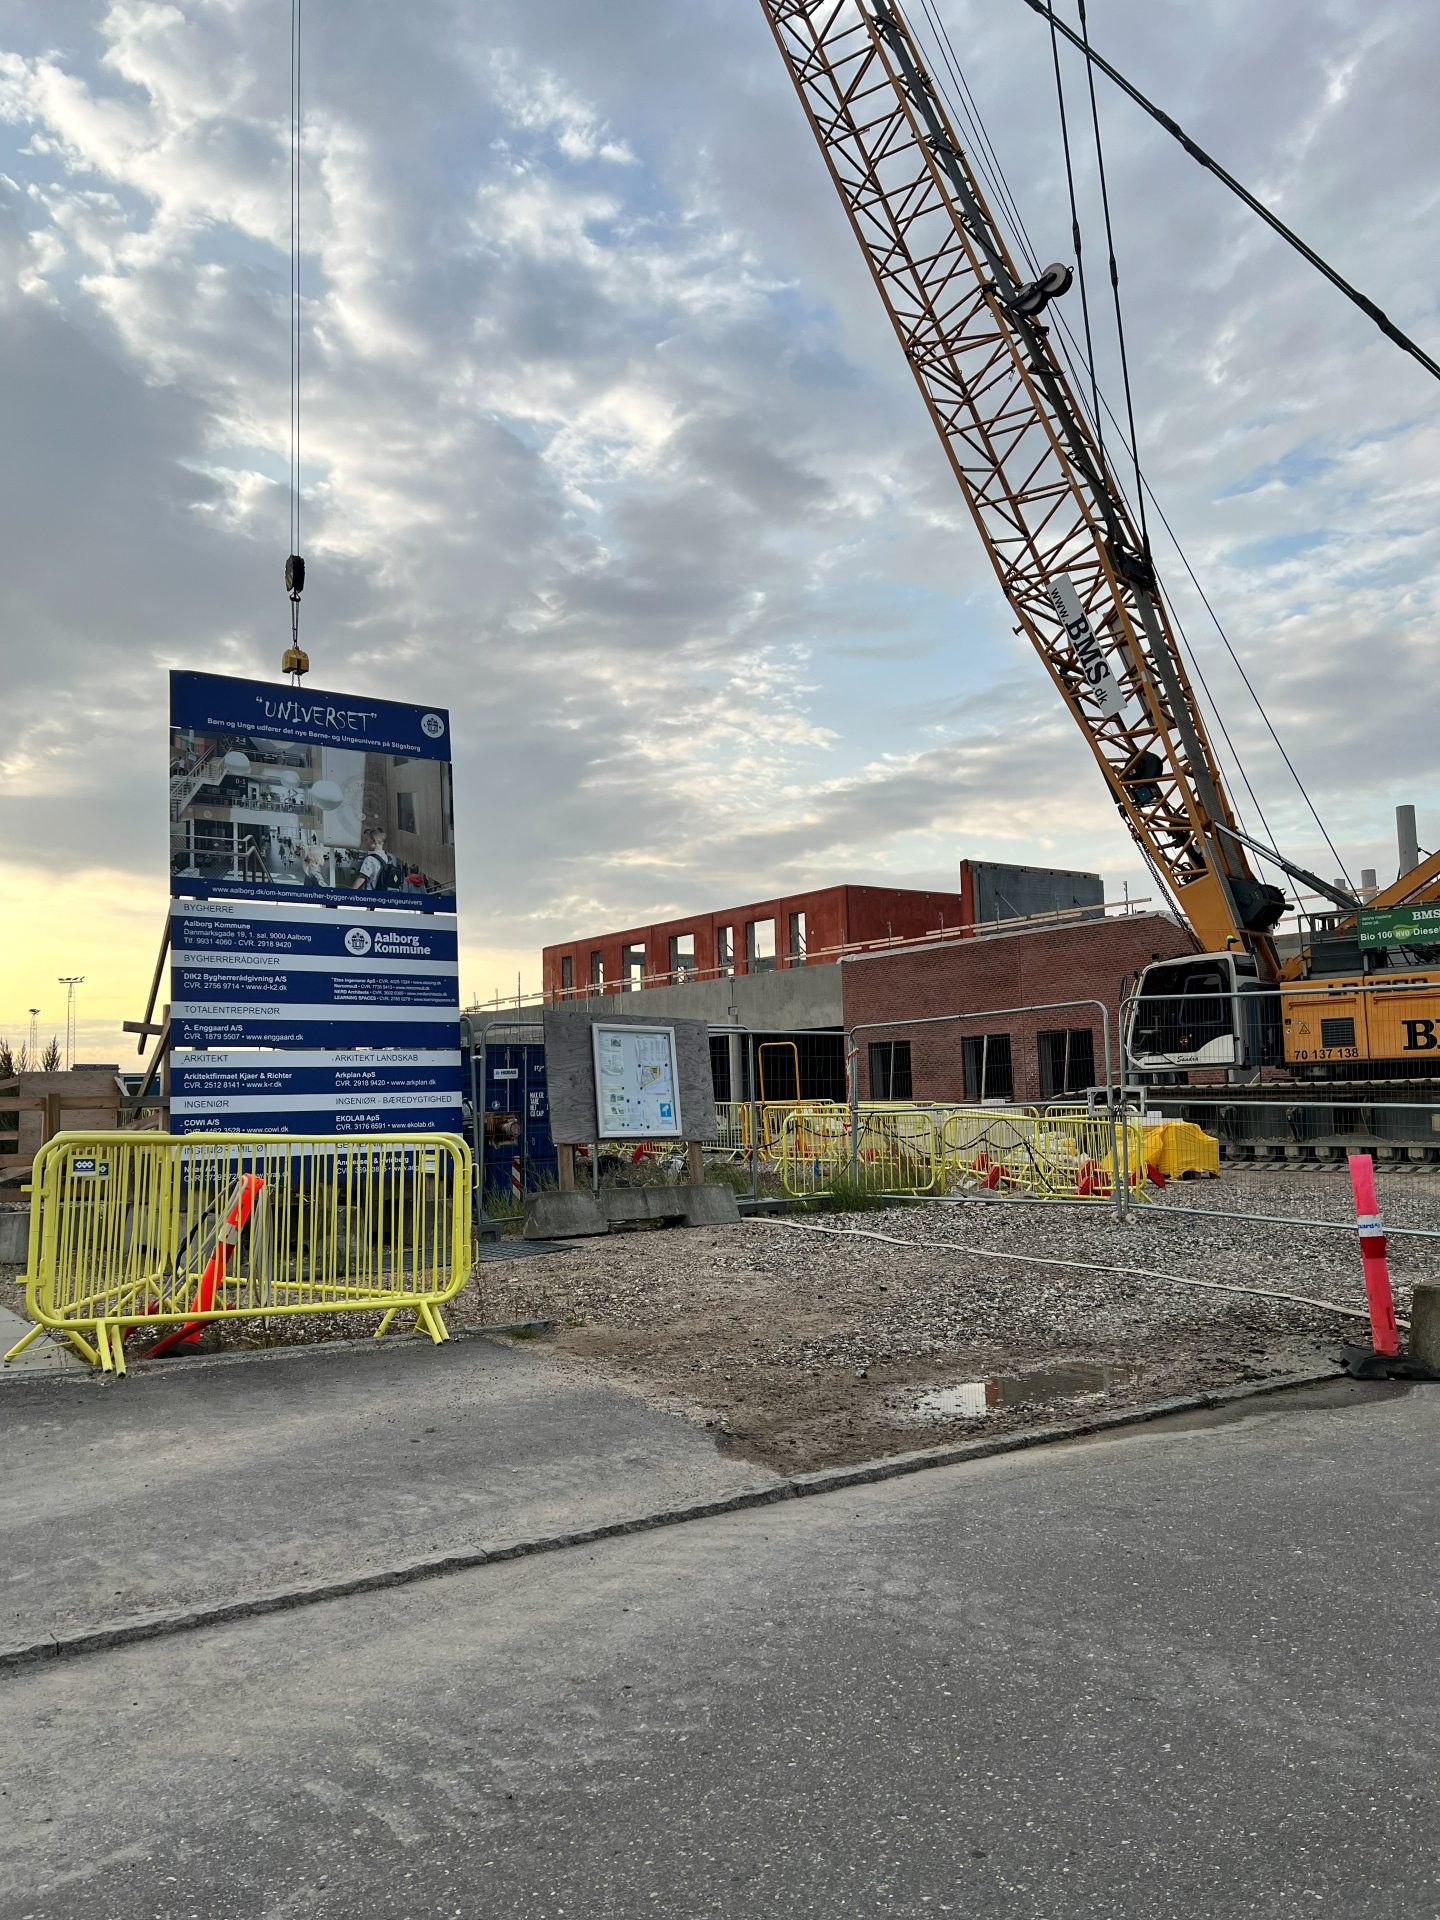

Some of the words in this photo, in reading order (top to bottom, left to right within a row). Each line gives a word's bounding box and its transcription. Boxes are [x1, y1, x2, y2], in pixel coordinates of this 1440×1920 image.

[1051, 588, 1110, 705] www.BMS.dk
[207, 717, 225, 726] Børn
[237, 722, 255, 730] Unge
[256, 724, 281, 733] udfører
[294, 729, 307, 737] nye
[332, 734, 341, 742] og
[342, 735, 381, 747] Ungeunivers
[382, 739, 391, 748] på
[391, 741, 421, 752] Stigsborg
[184, 903, 234, 913] BYGHERRE
[1412, 909, 1440, 921] BMS
[184, 920, 213, 929] Aalborg
[214, 921, 251, 930] Kommune
[184, 929, 235, 938] Danmarksgade
[287, 933, 312, 943] Aalborg
[374, 932, 420, 946] Aalborg
[1360, 933, 1376, 941] Bio
[1377, 931, 1393, 939] 100
[1395, 929, 1410, 938] HVO
[1413, 927, 1440, 936] Diese
[184, 936, 194, 944] Tlf.
[196, 937, 213, 945] 9931
[215, 938, 232, 946] 4060
[238, 939, 256, 947] CVR.
[374, 942, 431, 955] Kommune
[184, 954, 280, 965] BYGHERRERÅDGIVER
[203, 973, 273, 983] Bygherrerådgivning
[184, 1005, 280, 1015] TOTALENTREPRENØR
[193, 1024, 229, 1033] Enggaard
[230, 1024, 243, 1032] A/S
[245, 1034, 304, 1042] www.enggaard.dk
[1401, 1019, 1440, 1051] B
[184, 1054, 229, 1062] ARKITEKT
[335, 1054, 375, 1062] ARKITEKT
[376, 1054, 419, 1062] LANDSKAB
[1294, 1050, 1308, 1060] 70
[1312, 1050, 1332, 1060] 137
[1337, 1048, 1359, 1059] 138
[184, 1072, 238, 1080] Arkitektfirmaet
[239, 1072, 258, 1080] Kjaer
[335, 1071, 361, 1079] Arkplan
[361, 1071, 376, 1079] ApS
[184, 1081, 202, 1089] CVR.
[204, 1081, 221, 1089] 2512
[184, 1100, 230, 1109] INGENIØR
[335, 1097, 376, 1105] INGENIØR
[382, 1095, 452, 1104] BÆREDYGTIGHED
[366, 1114, 380, 1122] ApS
[335, 1123, 352, 1131] CVR.
[354, 1122, 369, 1130] 3176
[391, 1121, 435, 1129] www.ekolab.dk
